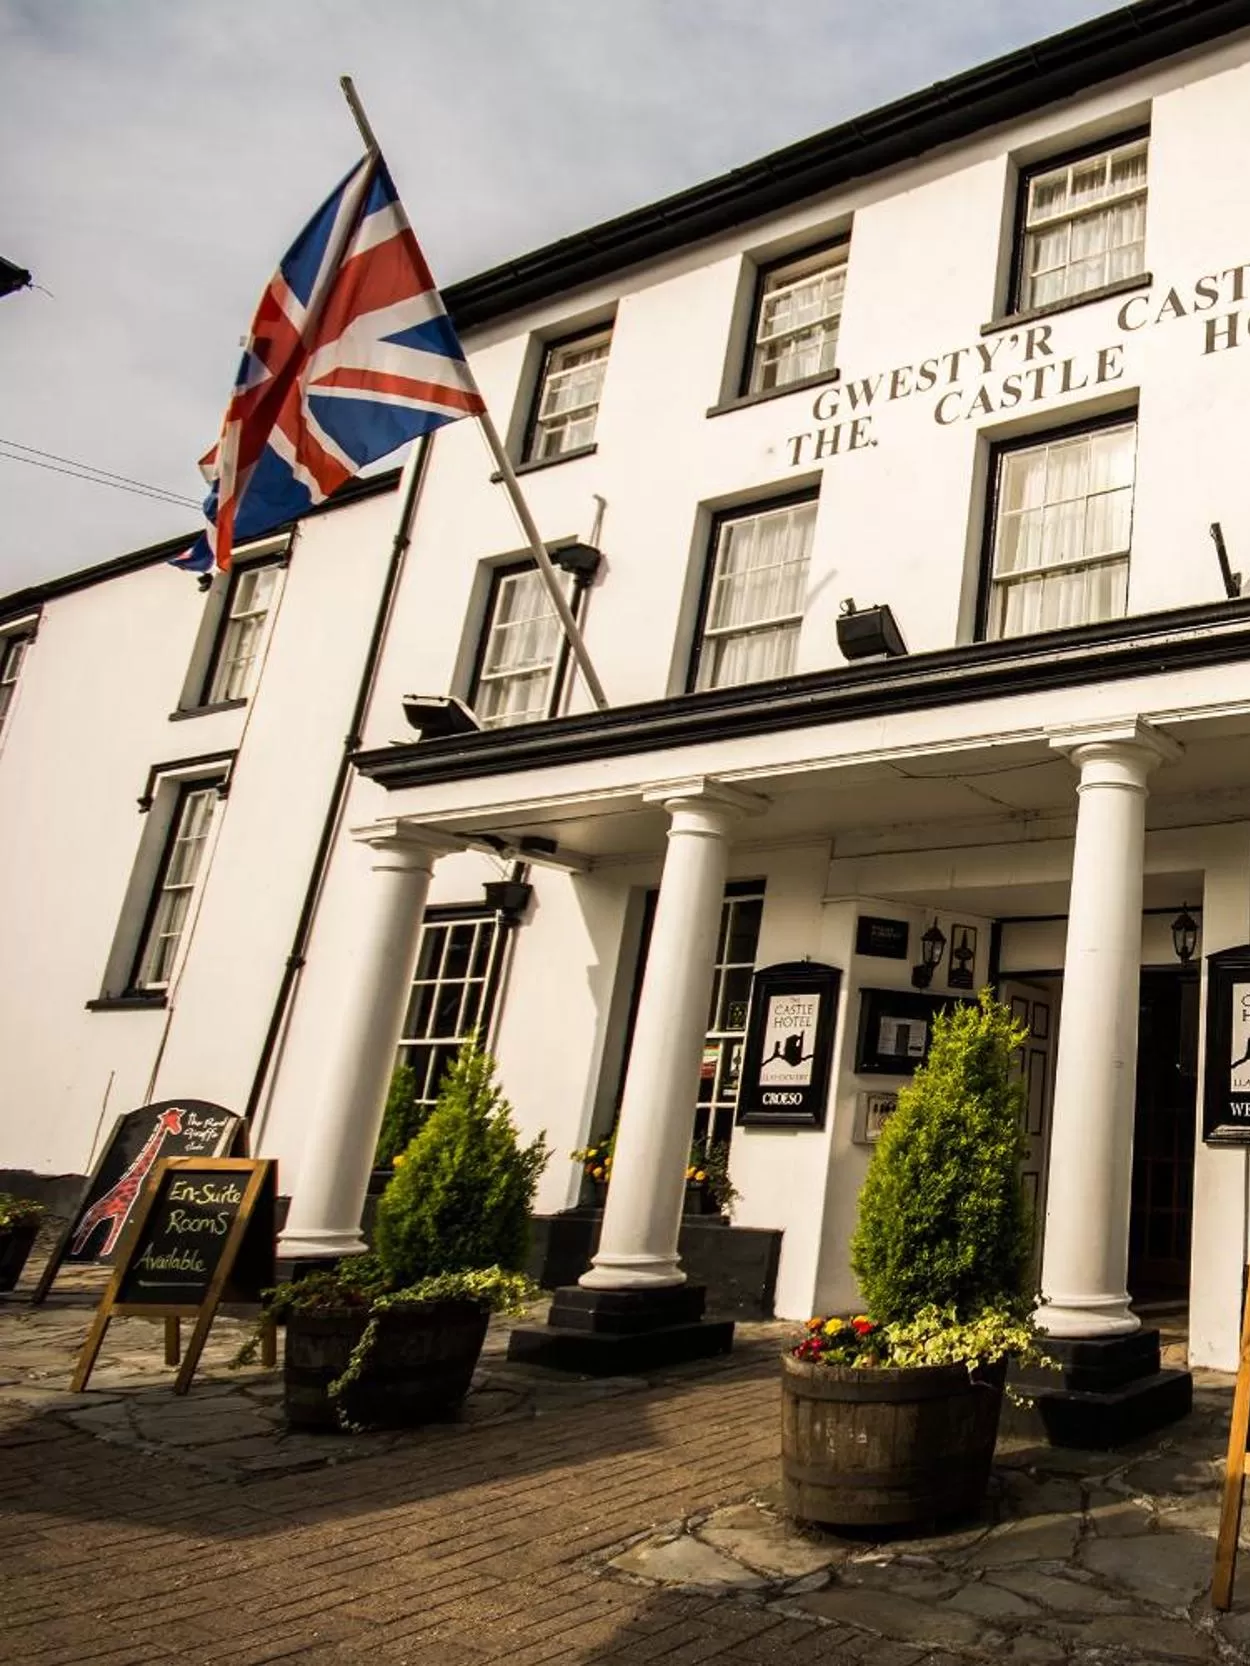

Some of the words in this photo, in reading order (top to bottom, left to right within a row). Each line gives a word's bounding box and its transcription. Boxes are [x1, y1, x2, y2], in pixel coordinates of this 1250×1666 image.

[812, 323, 1054, 421] GWESTY'R
[933, 344, 1125, 426] CASTLE
[774, 1003, 814, 1015] CASTLE
[774, 1015, 813, 1028] HOTEL
[762, 1092, 803, 1105] CROESO
[133, 1242, 207, 1273] Available
